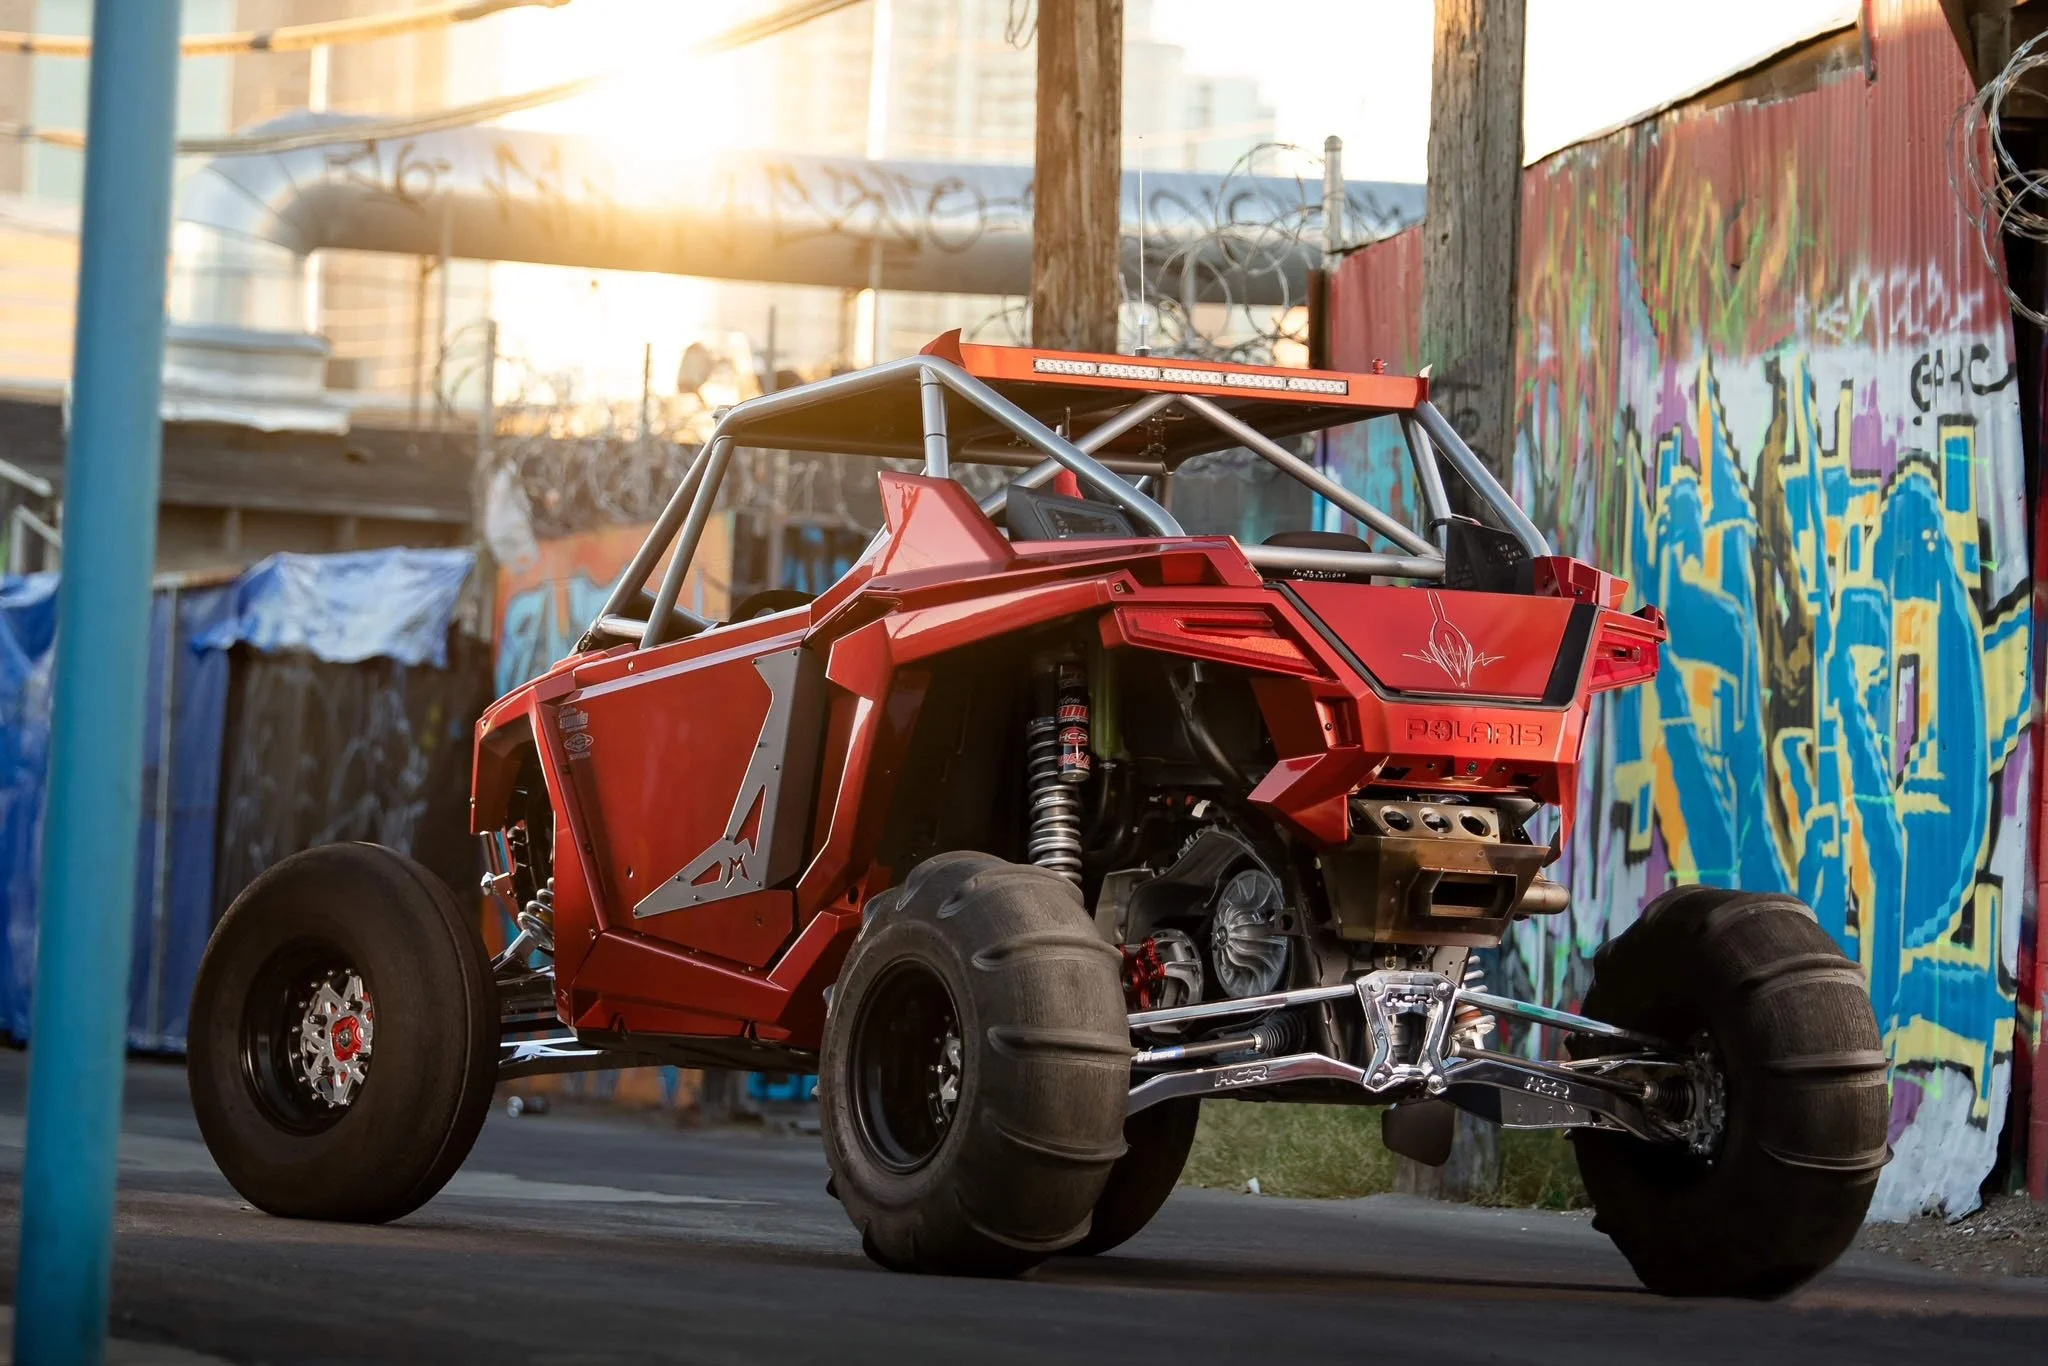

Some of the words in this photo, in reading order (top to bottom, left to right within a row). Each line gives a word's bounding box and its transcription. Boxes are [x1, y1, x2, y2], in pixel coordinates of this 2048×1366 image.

[1058, 732, 1089, 742] HCR
[1405, 718, 1544, 746] POLARIS
[1386, 992, 1434, 1006] HCR
[1214, 1065, 1269, 1088] HCR
[1523, 1076, 1570, 1099] HCR
